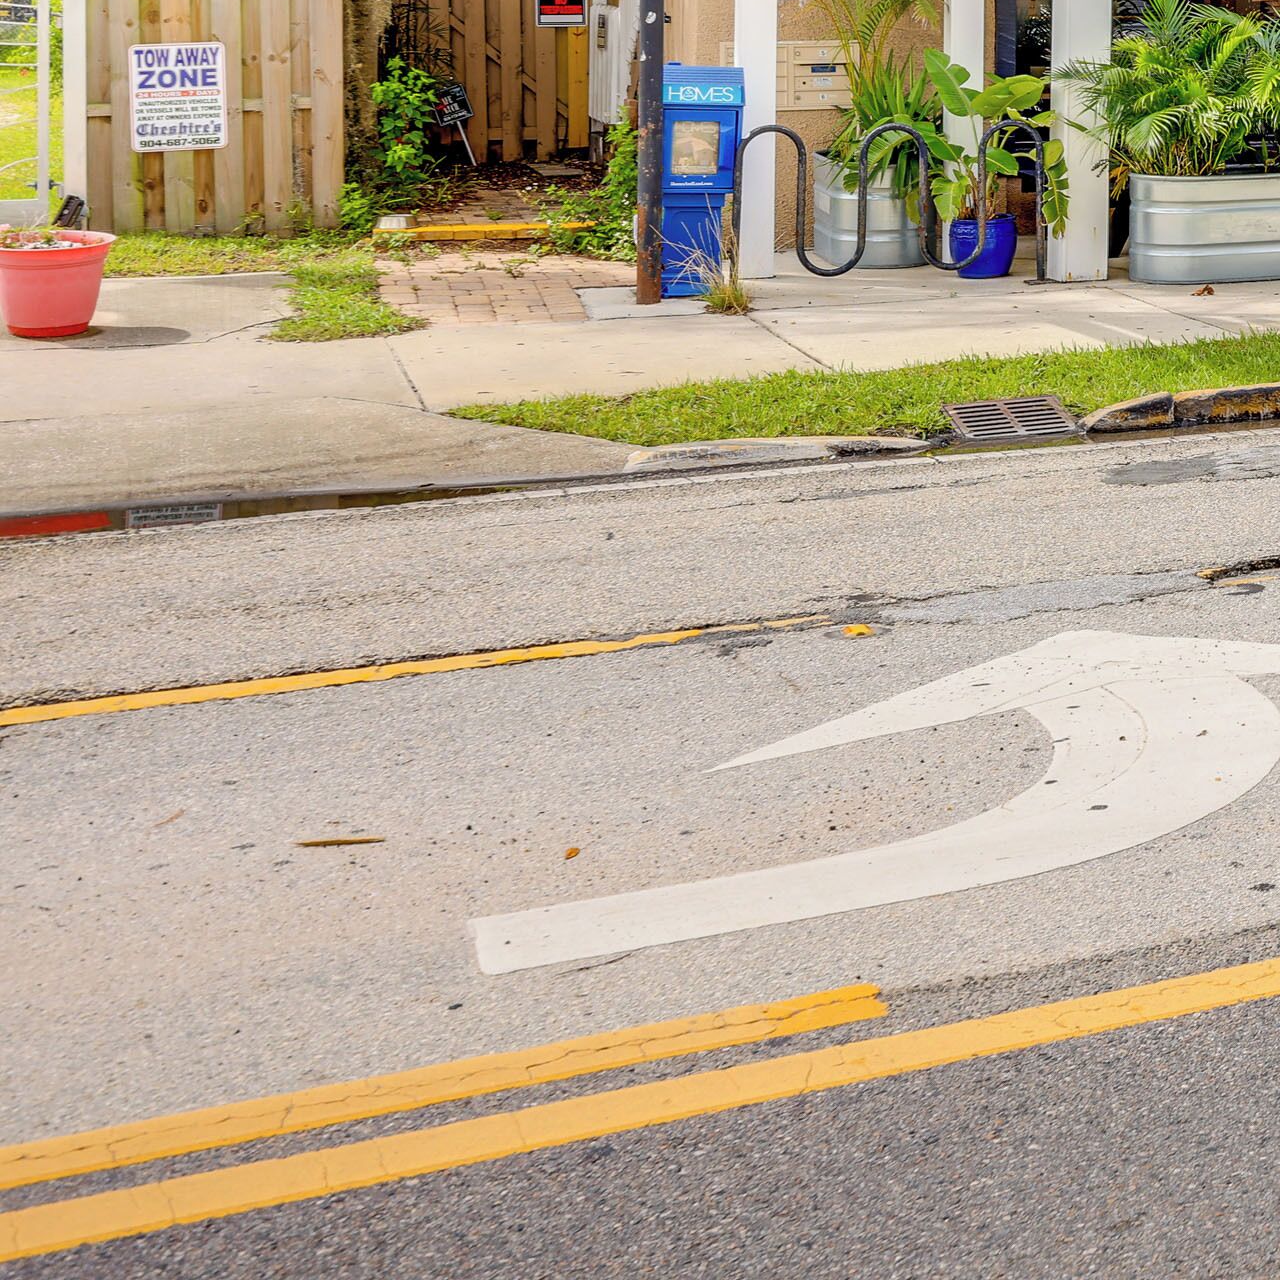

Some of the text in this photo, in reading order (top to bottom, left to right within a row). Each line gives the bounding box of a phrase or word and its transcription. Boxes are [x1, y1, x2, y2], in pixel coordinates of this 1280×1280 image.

[134, 47, 219, 68] TOW AWAY
[138, 68, 218, 89] ZONE
[668, 86, 734, 102] HOMES
[138, 99, 187, 107] UNAUTHORIZED
[136, 120, 222, 137] Cheshire's
[140, 137, 221, 148] 904-687-5062
